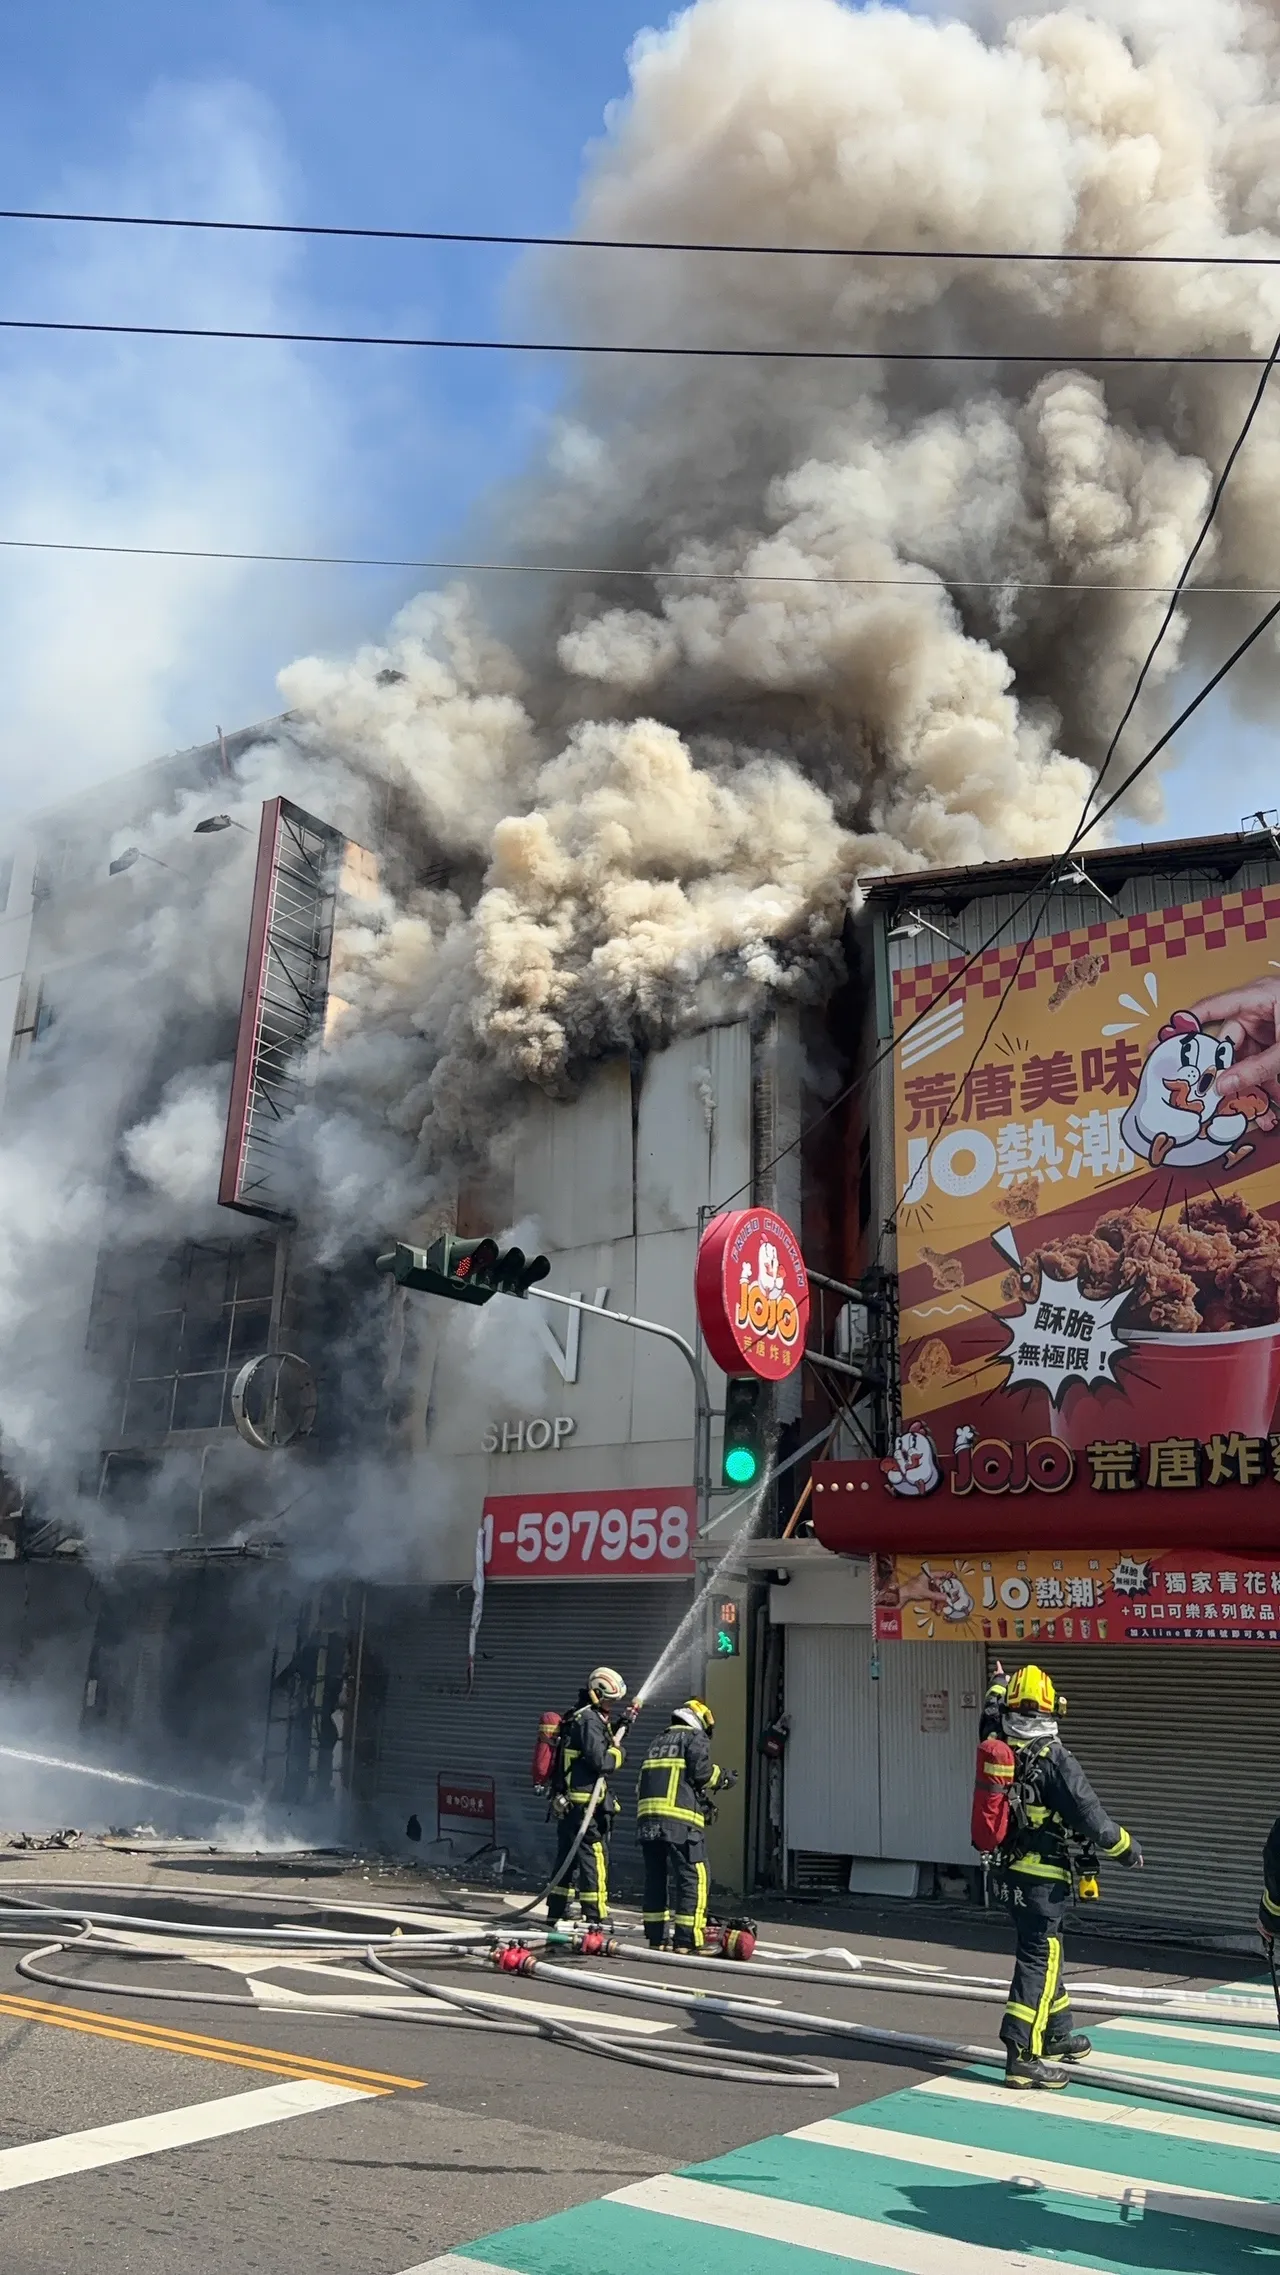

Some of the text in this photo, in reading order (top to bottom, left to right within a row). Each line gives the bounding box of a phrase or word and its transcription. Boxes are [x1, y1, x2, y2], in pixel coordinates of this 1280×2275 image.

[904, 1039, 1141, 1132] 荒唐美味
[903, 1106, 1135, 1204] JO熱潮
[731, 1217, 805, 1287] FRIED CHICKEN
[735, 1280, 800, 1346] JOJO
[1034, 1302, 1096, 1341] 酥脆
[1017, 1342, 1107, 1372] 無極限！
[481, 1417, 577, 1453] SHOP
[951, 1433, 1280, 1495] JOJO 荒唐炸
[983, 1576, 1095, 1609] JO熱潮
[1122, 1603, 1280, 1621] +可口可樂系列飲品
[648, 1744, 679, 1758] CFD
